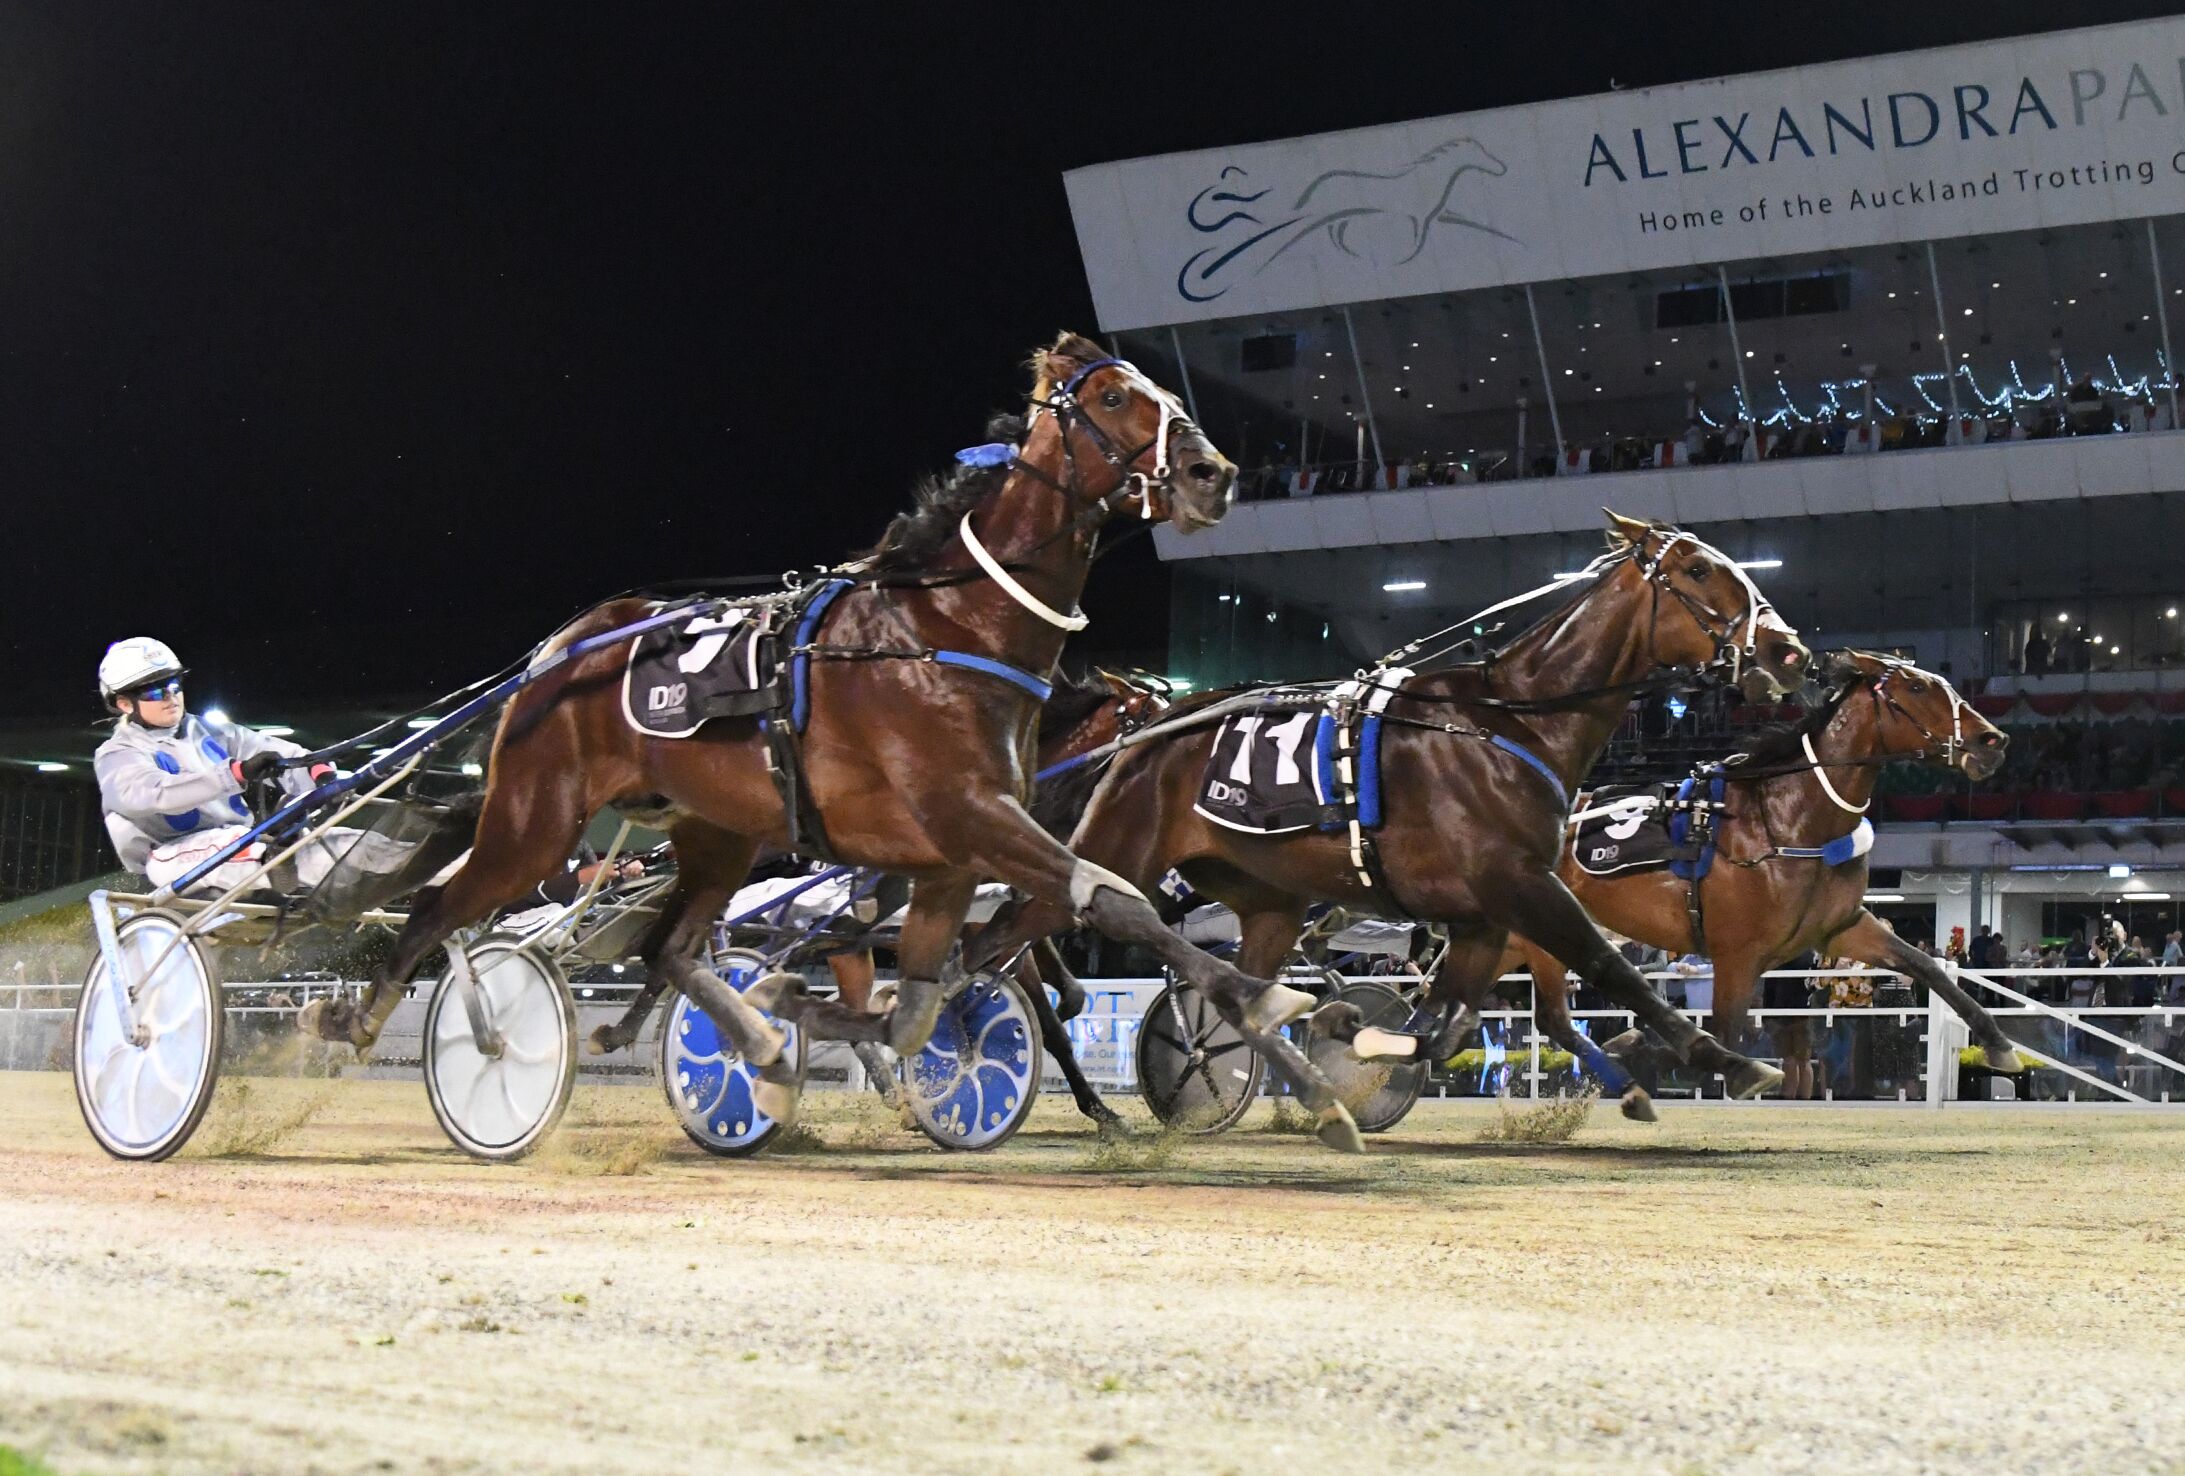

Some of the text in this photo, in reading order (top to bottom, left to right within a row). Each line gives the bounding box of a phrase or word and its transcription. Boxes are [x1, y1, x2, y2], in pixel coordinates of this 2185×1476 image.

[1640, 207, 1725, 233] Home
[1739, 199, 1769, 222] of
[1783, 194, 1833, 219] the
[1850, 173, 1999, 211] Auckland
[2012, 156, 2154, 194] Trotting
[677, 607, 753, 674] 7
[1229, 711, 1315, 786] 11
